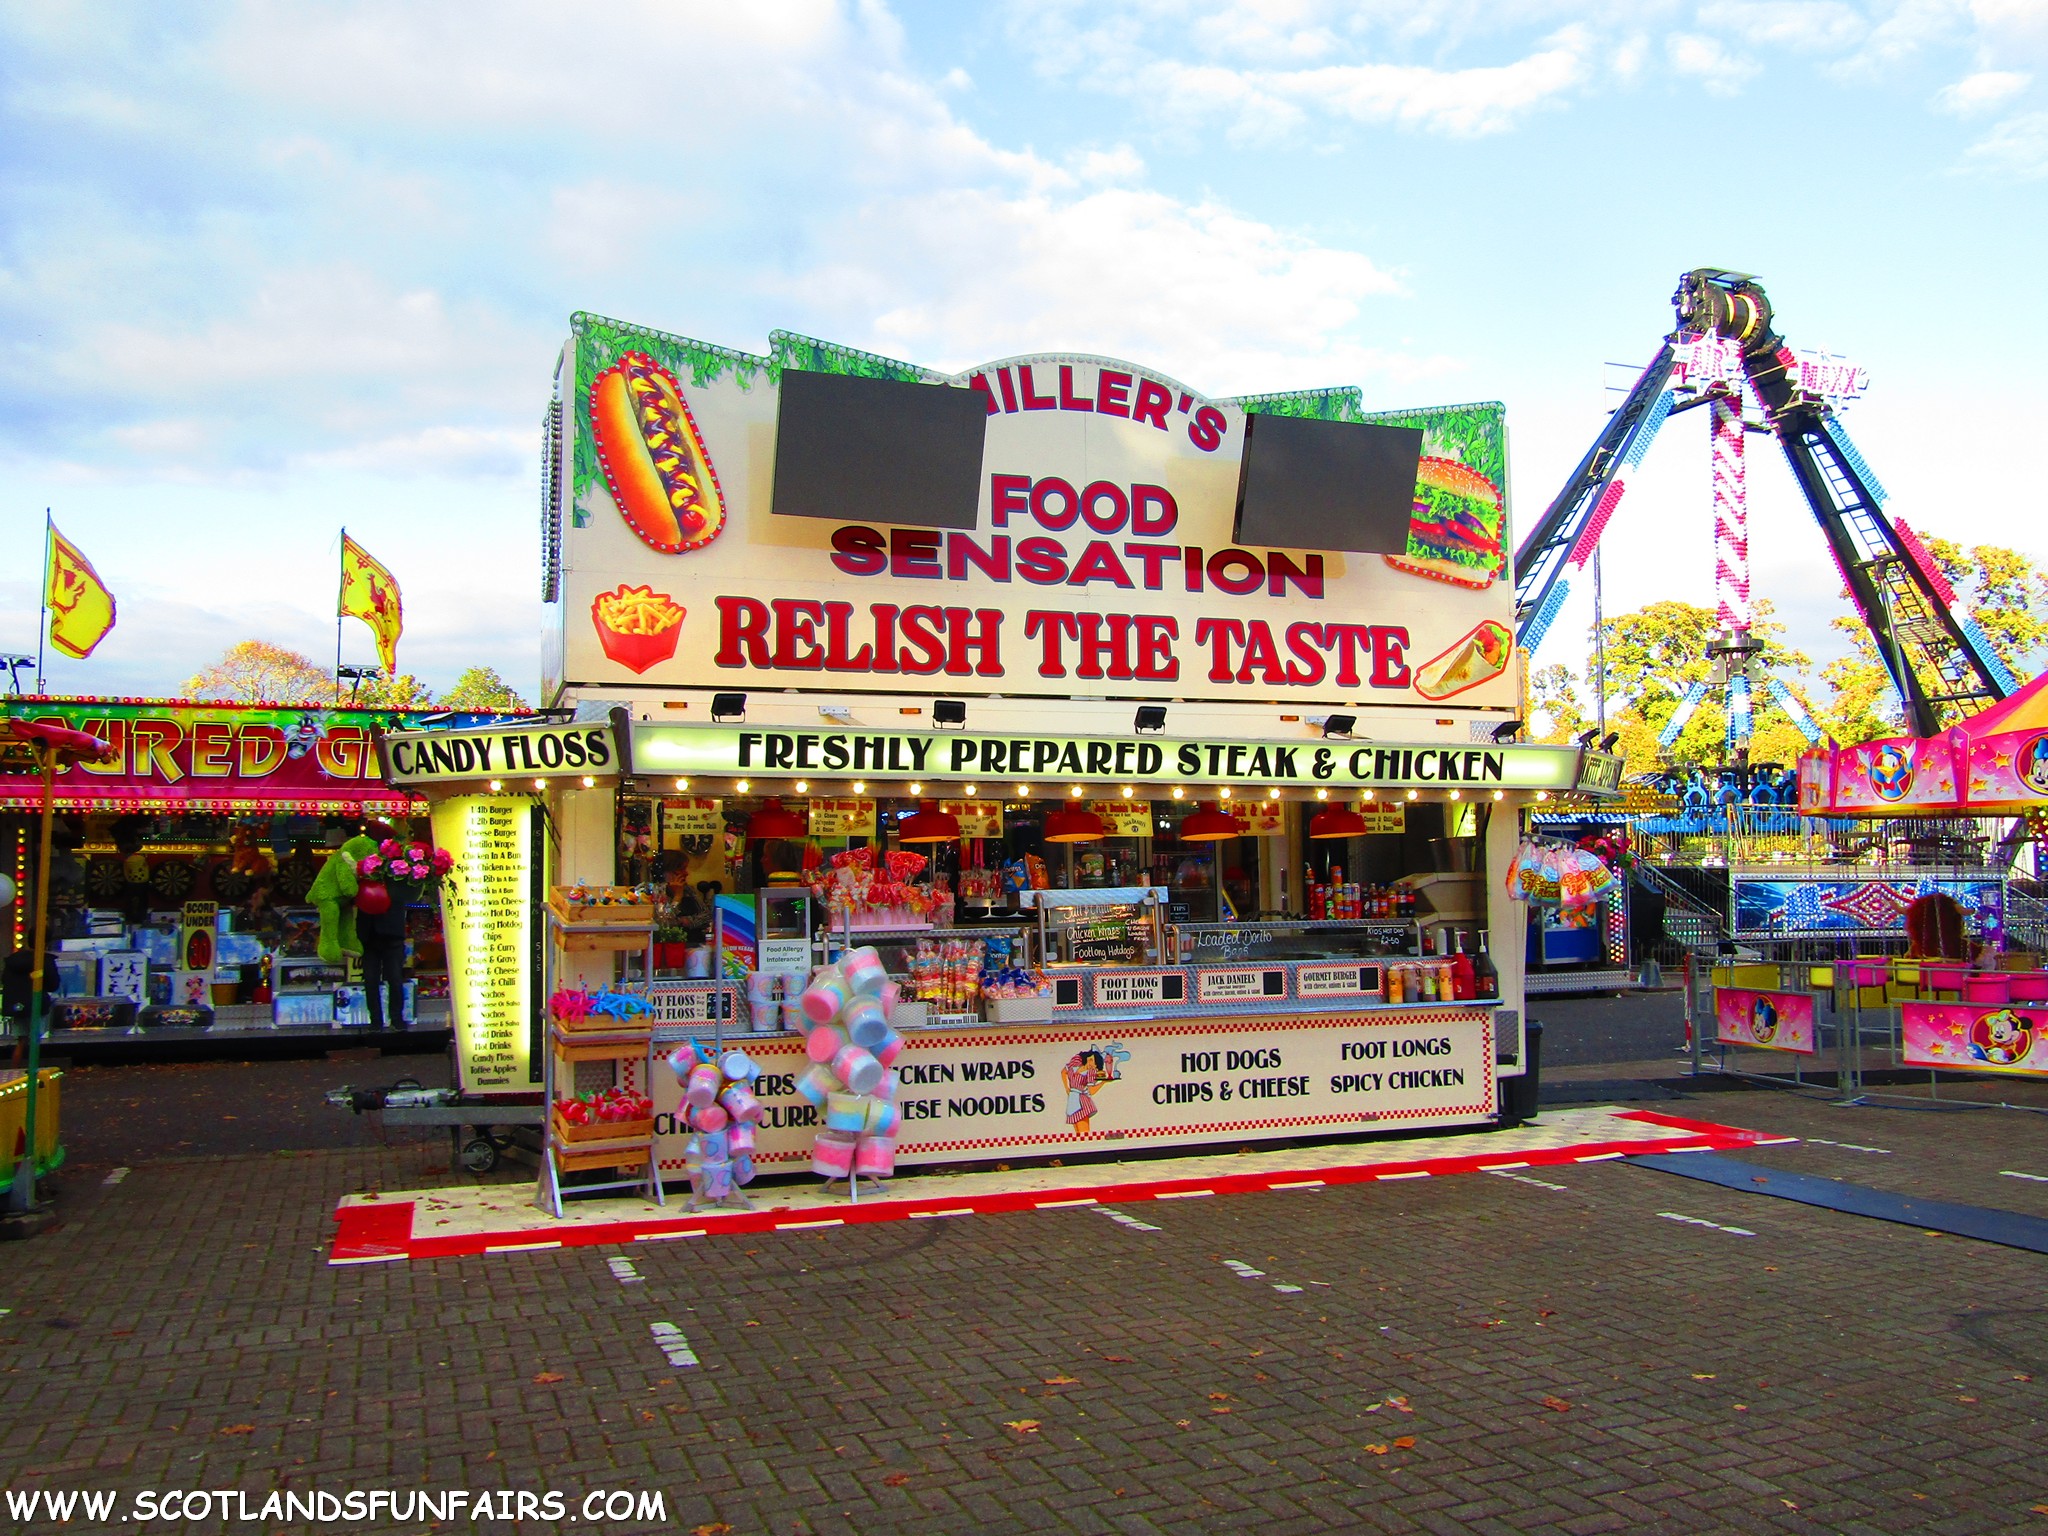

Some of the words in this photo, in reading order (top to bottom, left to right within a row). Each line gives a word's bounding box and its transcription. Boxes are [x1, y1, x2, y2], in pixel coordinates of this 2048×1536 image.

[990, 473, 1179, 537] FOOD
[830, 526, 1325, 599] SENSATION
[714, 596, 1005, 677] RELISH
[1024, 609, 1180, 682] THE
[1194, 616, 1411, 689] TASTE
[392, 737, 492, 775] CANDY
[502, 730, 611, 770] FLOSS
[738, 733, 933, 771] FRESHLY
[950, 739, 1163, 775] PREPARED
[1177, 744, 1300, 779] STEAK
[1311, 747, 1336, 780] &
[1348, 747, 1504, 782] CHICKEN
[490, 805, 513, 815] Burger
[490, 817, 513, 827] Burger
[493, 828, 517, 838] Burger
[494, 840, 516, 850] Wraps
[186, 902, 215, 914] SCORE
[491, 909, 504, 917] Hot
[505, 909, 520, 918] Dog
[185, 915, 215, 927] UNDER
[482, 932, 502, 942] Chips
[1066, 926, 1096, 941] Chicken
[1197, 930, 1241, 948] Loaded
[489, 944, 495, 952] &
[497, 943, 516, 953] Curry
[489, 955, 495, 964] &
[486, 967, 492, 975] &
[494, 967, 520, 975] Cheese
[1303, 971, 1331, 982] GOURMET
[1333, 970, 1357, 981] BURGER
[490, 979, 496, 987] &
[498, 978, 516, 986] Chilli
[1101, 978, 1128, 989] FOOT
[1132, 977, 1158, 988] LONG
[1208, 975, 1225, 986] JACK
[1227, 974, 1256, 985] DANIELS
[666, 994, 695, 1007] FLOSS
[1106, 990, 1128, 1001] HOT
[1131, 989, 1153, 1000] DOG
[666, 1007, 695, 1020] FLOSS
[491, 1030, 513, 1039] Drinks
[489, 1041, 512, 1050] Drinks
[1341, 1041, 1387, 1060] FOOT
[1392, 1037, 1451, 1058] LONGS
[472, 1054, 495, 1064] Candy
[1181, 1052, 1221, 1073] HOT
[1227, 1048, 1282, 1071] DOGS
[470, 1065, 491, 1074] Toffee
[493, 1064, 517, 1075] Apples
[962, 1060, 1035, 1080] WRAPS
[1330, 1073, 1382, 1094] SPICY
[1388, 1068, 1464, 1089] CHICKEN
[1152, 1080, 1213, 1104] CHIPS
[1220, 1081, 1233, 1101] &
[1239, 1075, 1310, 1098] CHEESE
[948, 1093, 1046, 1118] NOODLES
[757, 1105, 826, 1129] CURR
